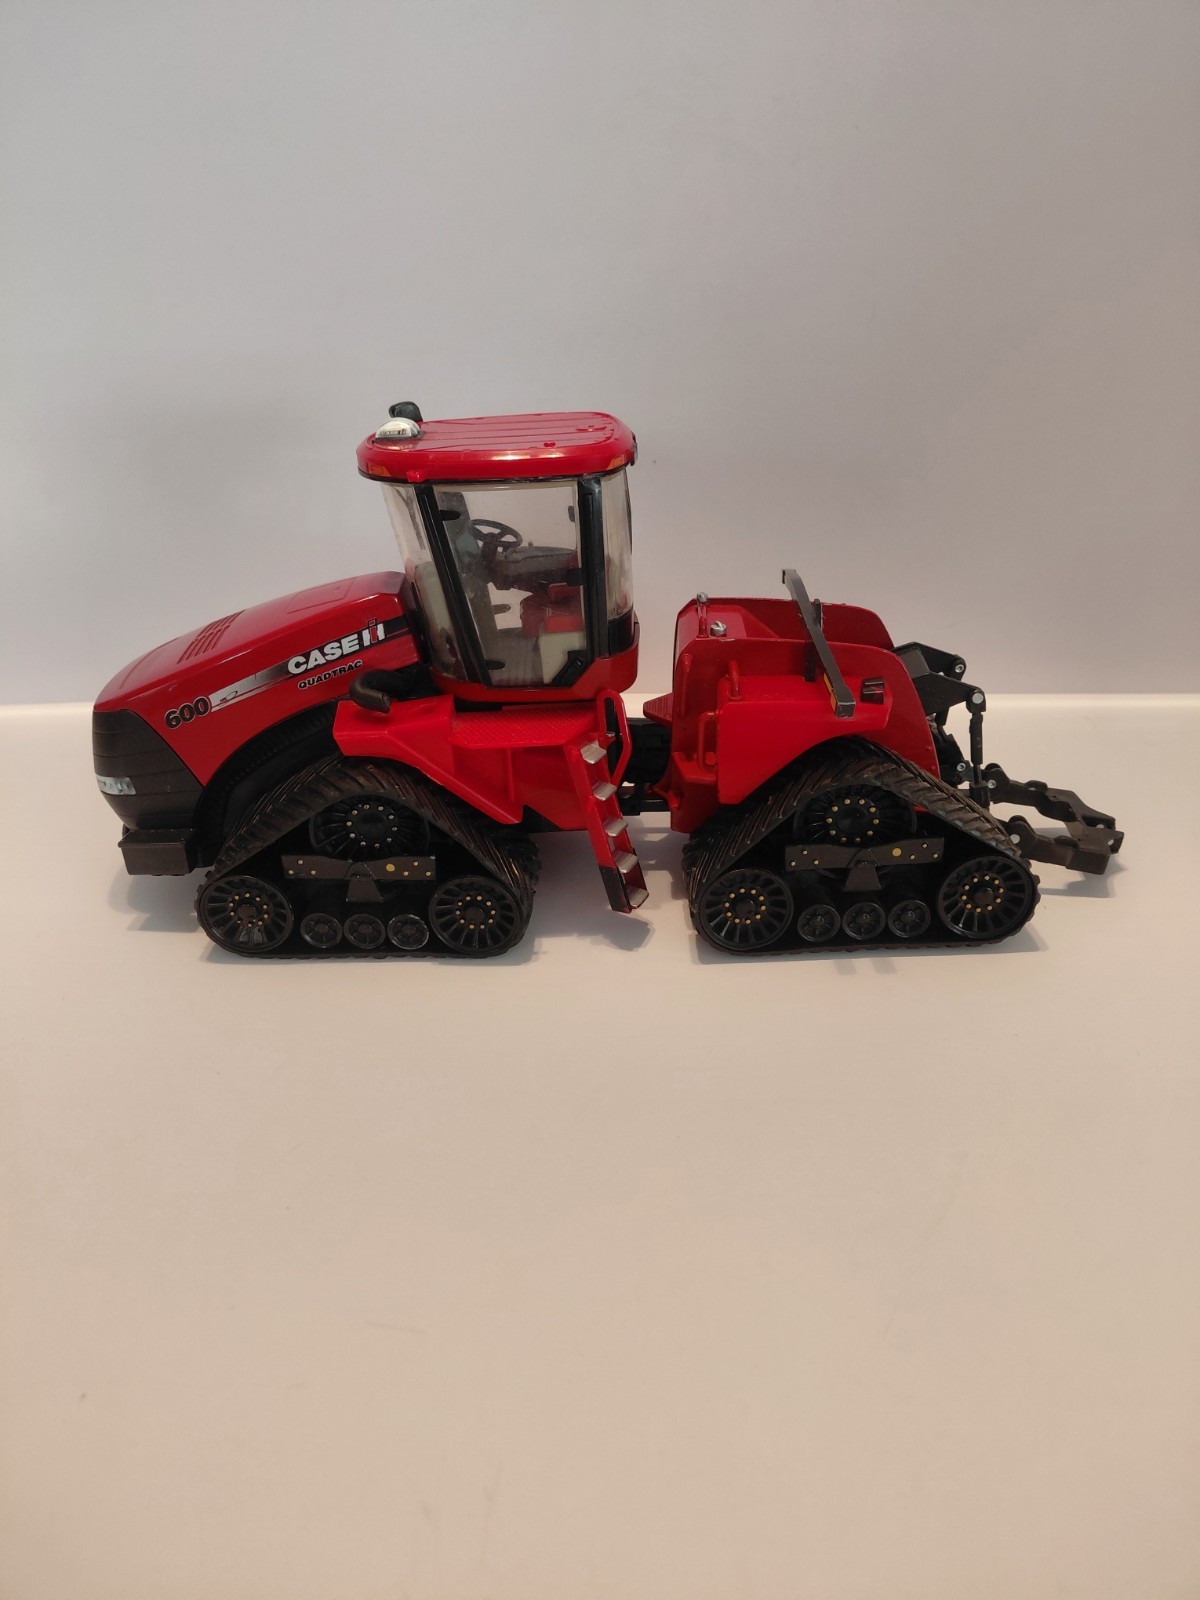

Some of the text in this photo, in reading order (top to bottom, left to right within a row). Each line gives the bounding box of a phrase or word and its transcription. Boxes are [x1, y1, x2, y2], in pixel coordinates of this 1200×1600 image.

[287, 634, 360, 674] CASE
[297, 660, 363, 690] QUADTRAC
[164, 697, 211, 729] 600
